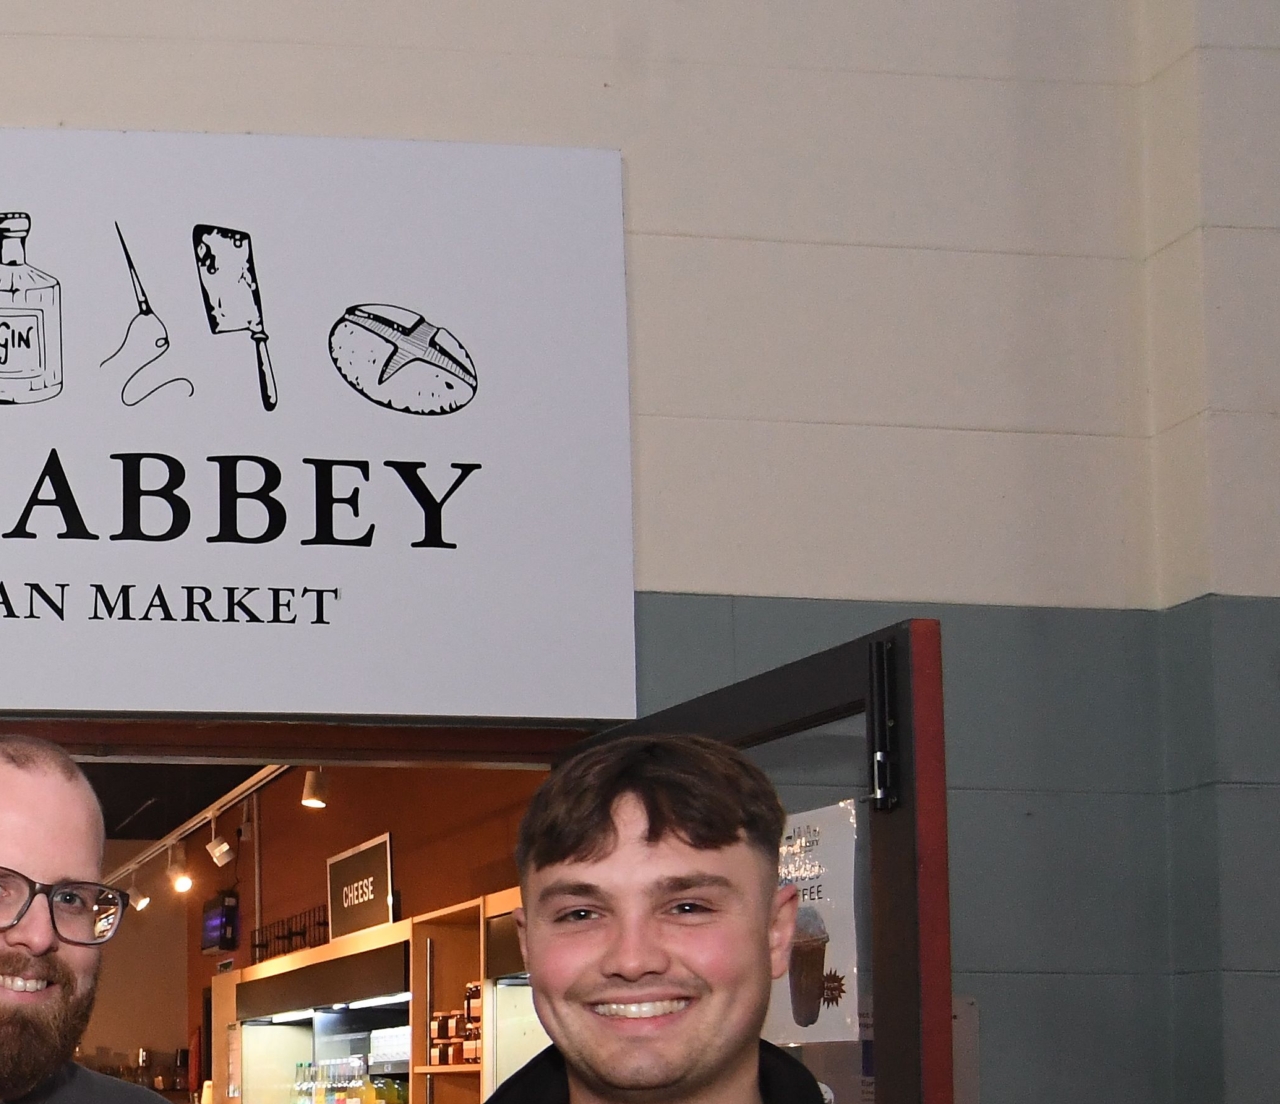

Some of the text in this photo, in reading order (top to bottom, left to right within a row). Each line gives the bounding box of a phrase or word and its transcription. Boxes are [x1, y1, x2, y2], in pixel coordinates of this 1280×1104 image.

[2, 449, 482, 549] ABBEY
[89, 583, 339, 626] MARKET
[342, 876, 374, 908] CHEESE
